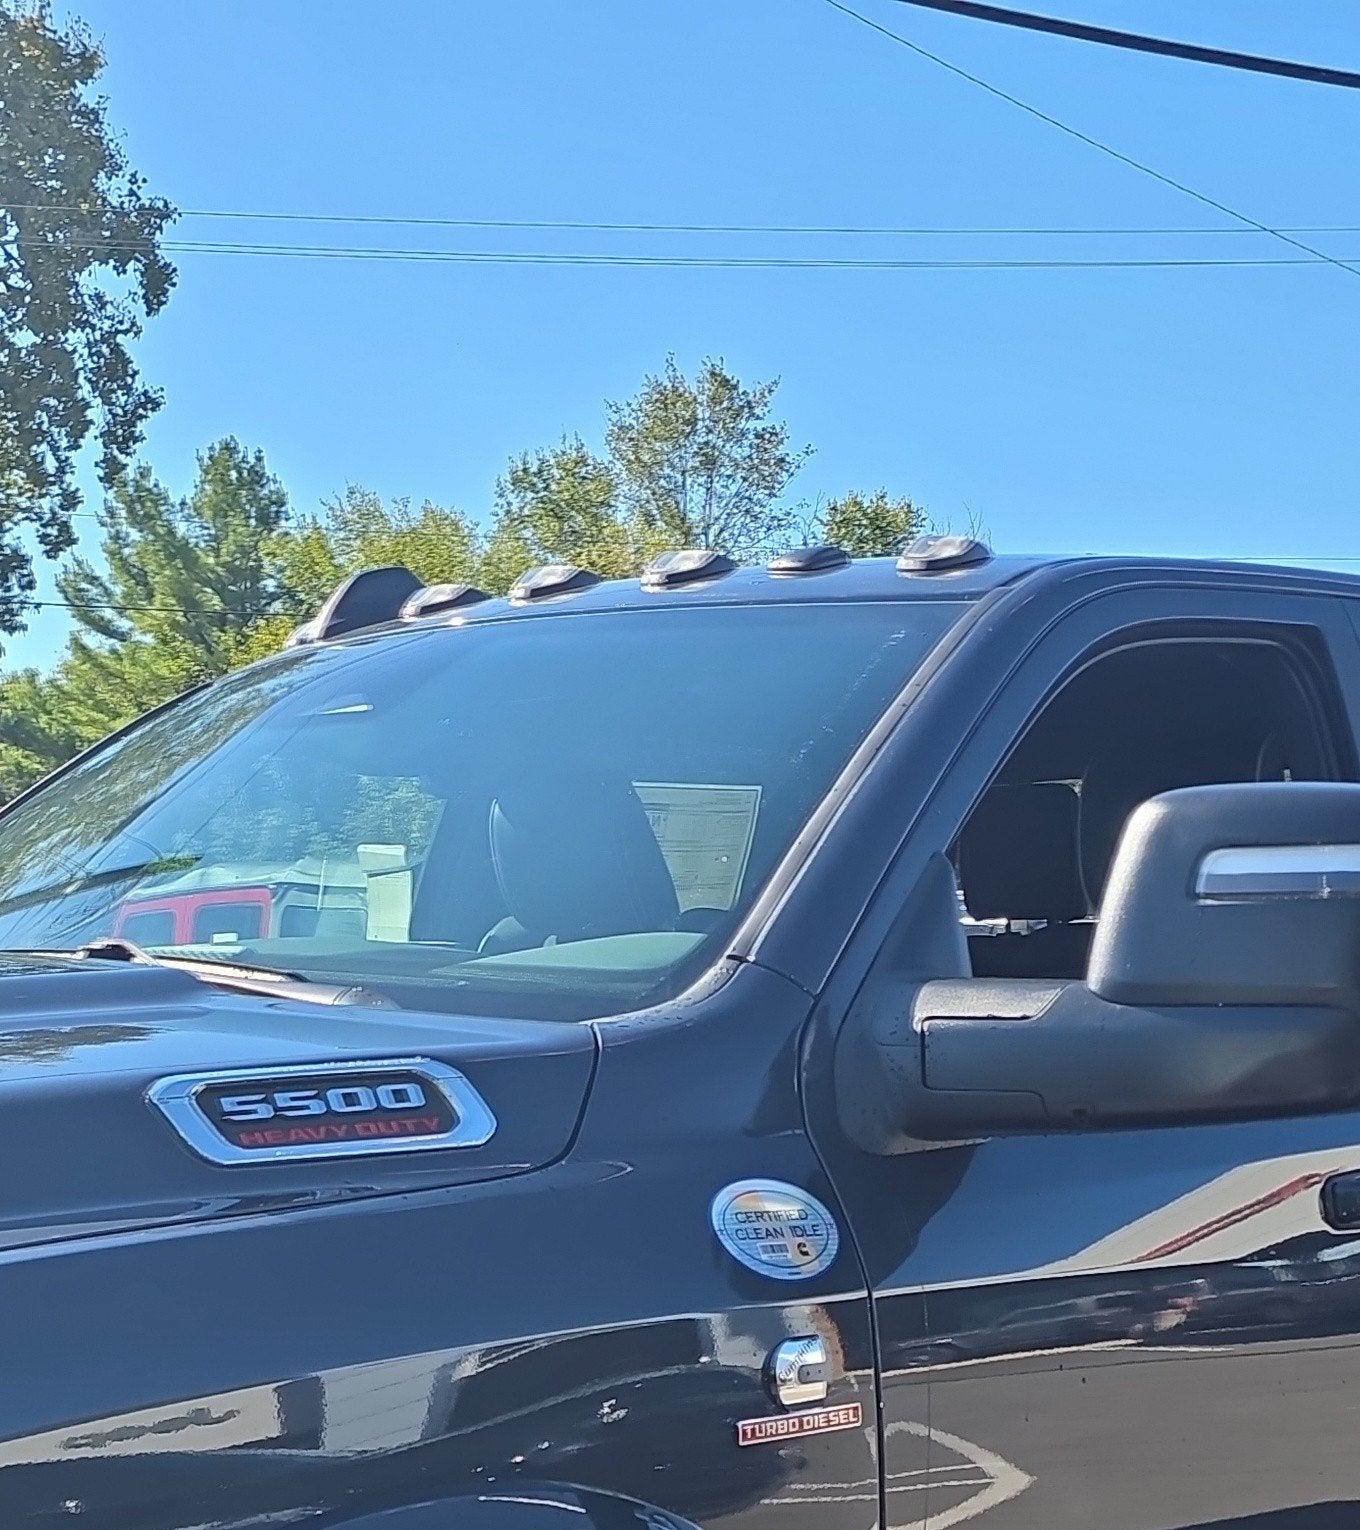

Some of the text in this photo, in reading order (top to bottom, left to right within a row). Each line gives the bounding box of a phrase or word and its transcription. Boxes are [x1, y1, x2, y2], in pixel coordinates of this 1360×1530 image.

[218, 1082, 427, 1121] 5500
[239, 1116, 440, 1145] HEAVY DUTY
[734, 1209, 809, 1224] CERTIFIED
[734, 1224, 824, 1241] CLEAN IDLE
[742, 1407, 859, 1440] TURBO DIESEL
